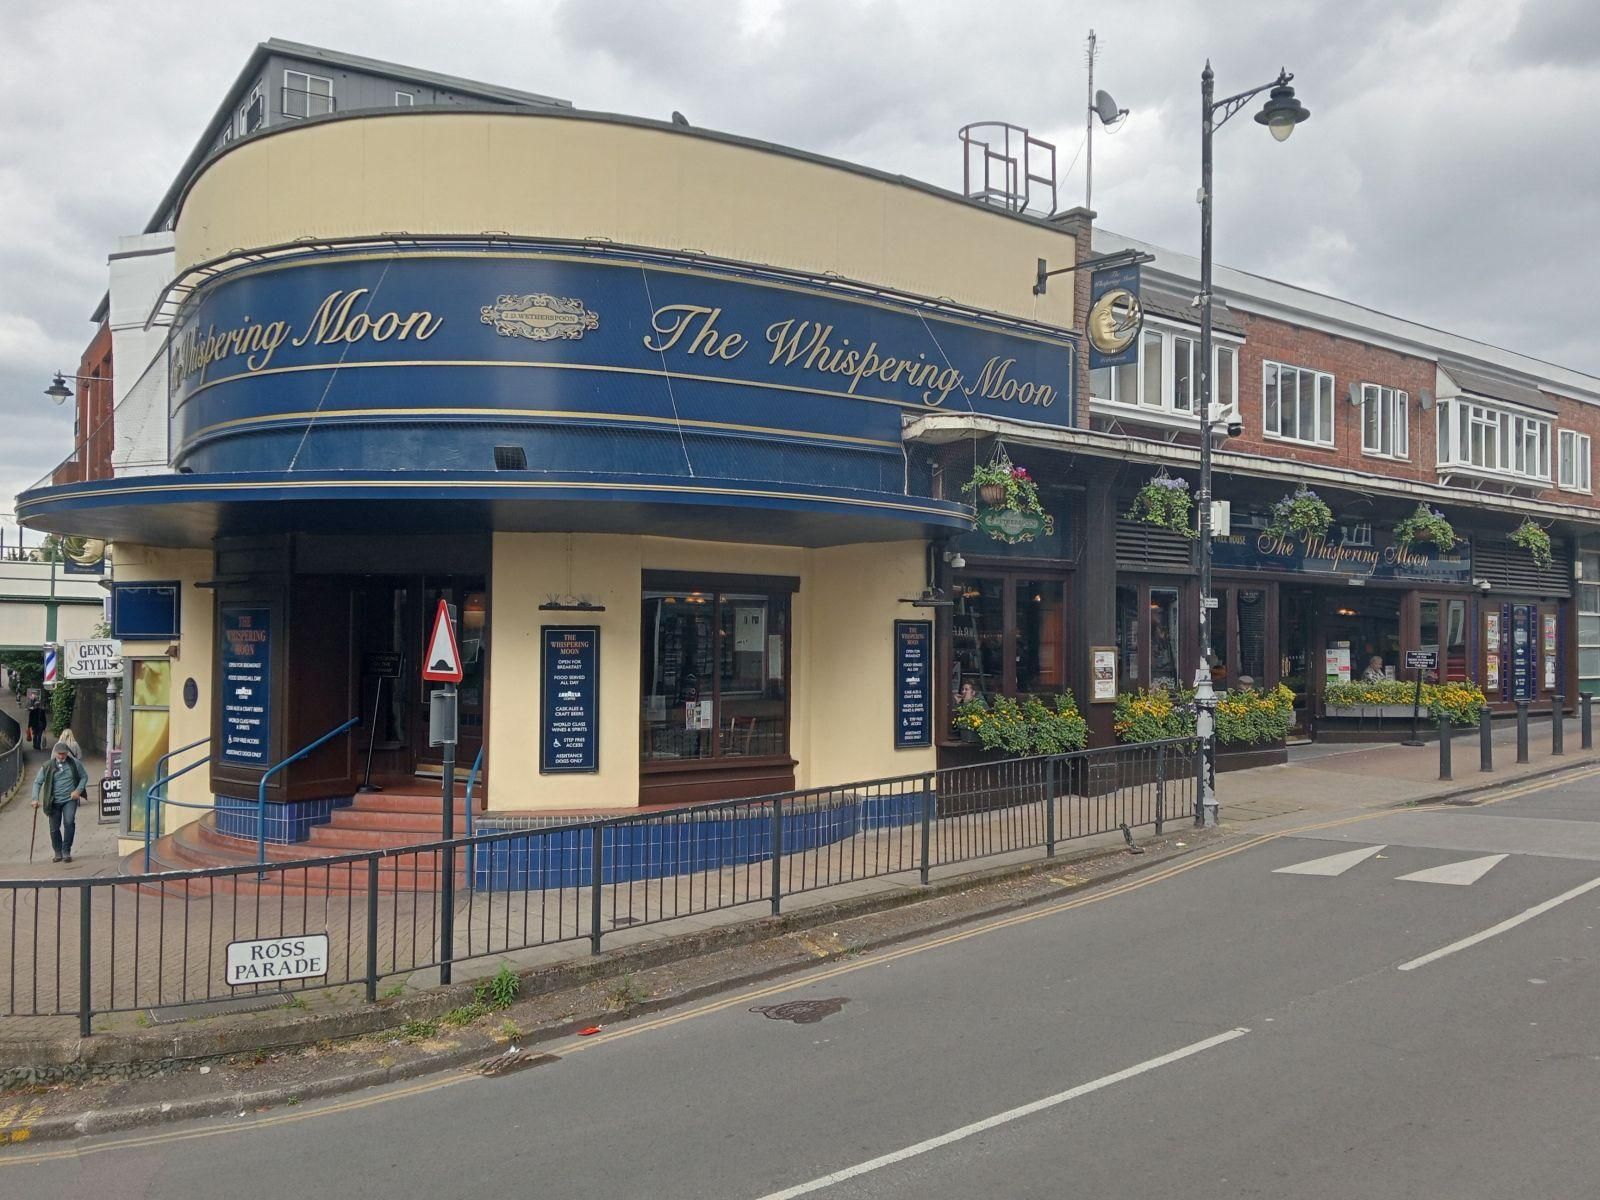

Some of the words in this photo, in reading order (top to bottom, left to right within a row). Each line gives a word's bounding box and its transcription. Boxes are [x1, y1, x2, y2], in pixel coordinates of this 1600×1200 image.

[292, 288, 443, 346] Moon
[519, 313, 576, 322] WETHERSPOON
[643, 303, 749, 360] The
[765, 318, 964, 407] Whispering
[964, 355, 1058, 409] Moon
[1257, 530, 1295, 556] The
[1299, 527, 1379, 577] Whispering
[1383, 543, 1430, 568] Moon
[79, 644, 114, 658] GENTS
[103, 780, 121, 791] OPE
[251, 941, 305, 960] ROSS
[235, 957, 321, 980] PARADE
